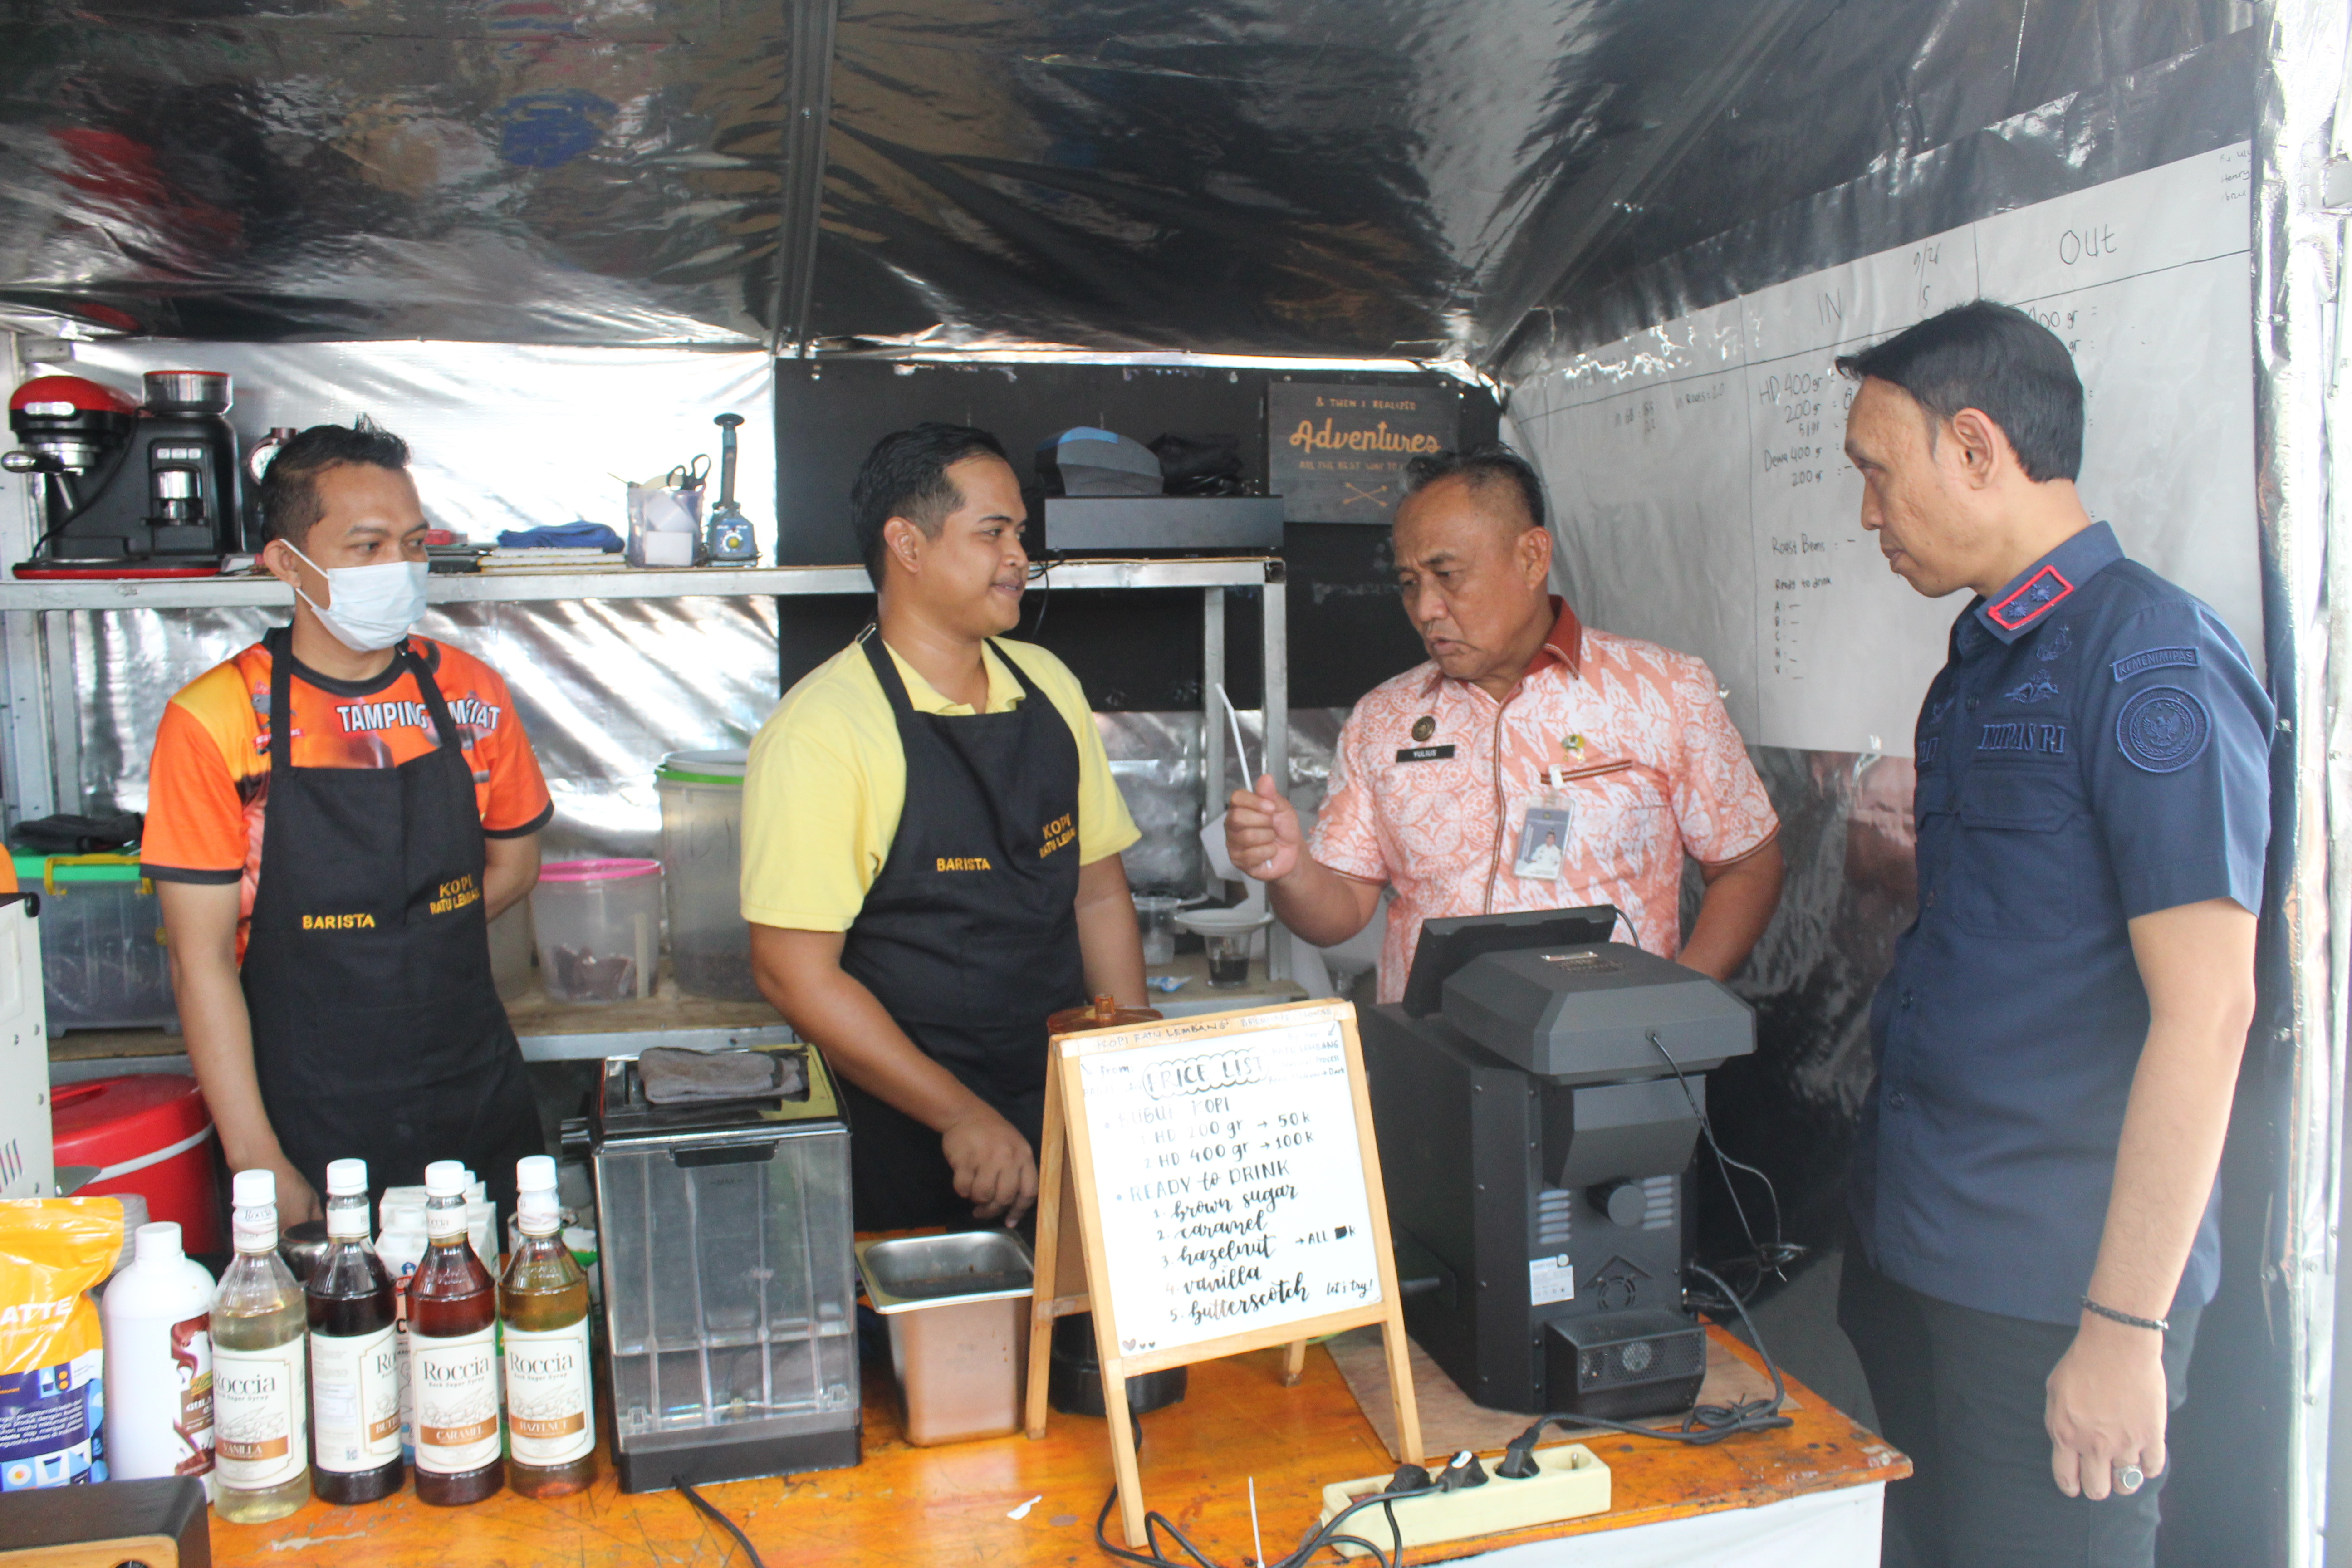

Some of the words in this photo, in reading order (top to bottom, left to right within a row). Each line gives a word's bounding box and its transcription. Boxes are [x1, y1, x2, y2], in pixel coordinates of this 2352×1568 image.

[1818, 289, 1843, 326] IN
[1759, 375, 1780, 405] HD
[1330, 398, 1357, 407] THEN
[1289, 417, 1441, 453] Adventures
[2118, 651, 2192, 676] KEMENIMIPAS
[337, 700, 428, 732] TAMPING
[2039, 724, 2067, 754] RI
[1413, 750, 1436, 758] YULIUS
[1043, 813, 1071, 839] KOPI
[936, 858, 991, 872] BARISTA
[439, 874, 472, 898] KOPI
[430, 898, 452, 915] RATU
[302, 913, 375, 929] BARISTA
[1097, 1037, 1128, 1049] KOPI
[1134, 1031, 1161, 1043] RATU
[1299, 1039, 1339, 1053] LEMBANG
[1147, 1064, 1209, 1093] PRICE
[1222, 1056, 1264, 1079] LIST
[1328, 1066, 1346, 1076] Dark
[1191, 1097, 1230, 1116] KOPI
[1155, 1129, 1176, 1144] HD
[1186, 1121, 1220, 1139] 200
[1226, 1120, 1244, 1139] gr
[1159, 1152, 1180, 1167] HD
[1190, 1144, 1225, 1162] 400
[1232, 1142, 1249, 1161] gr
[1130, 1176, 1190, 1202] READY
[1197, 1172, 1221, 1191] to
[1229, 1159, 1290, 1185] DRINK
[1170, 1199, 1233, 1221] brown
[1242, 1184, 1298, 1212] sugar
[1174, 1210, 1268, 1239] caramel
[1178, 1235, 1276, 1269] hazelnut
[1308, 1230, 1328, 1244] ALL
[1183, 1265, 1262, 1294] vanilla
[1352, 1279, 1373, 1298] try!
[39, 1321, 62, 1330] Drik
[423, 1357, 489, 1381] Roccia
[510, 1352, 573, 1375] Roccia
[215, 1371, 275, 1395] Roccia
[436, 1425, 483, 1440] CARAMEL
[224, 1441, 263, 1455] VANILLA
